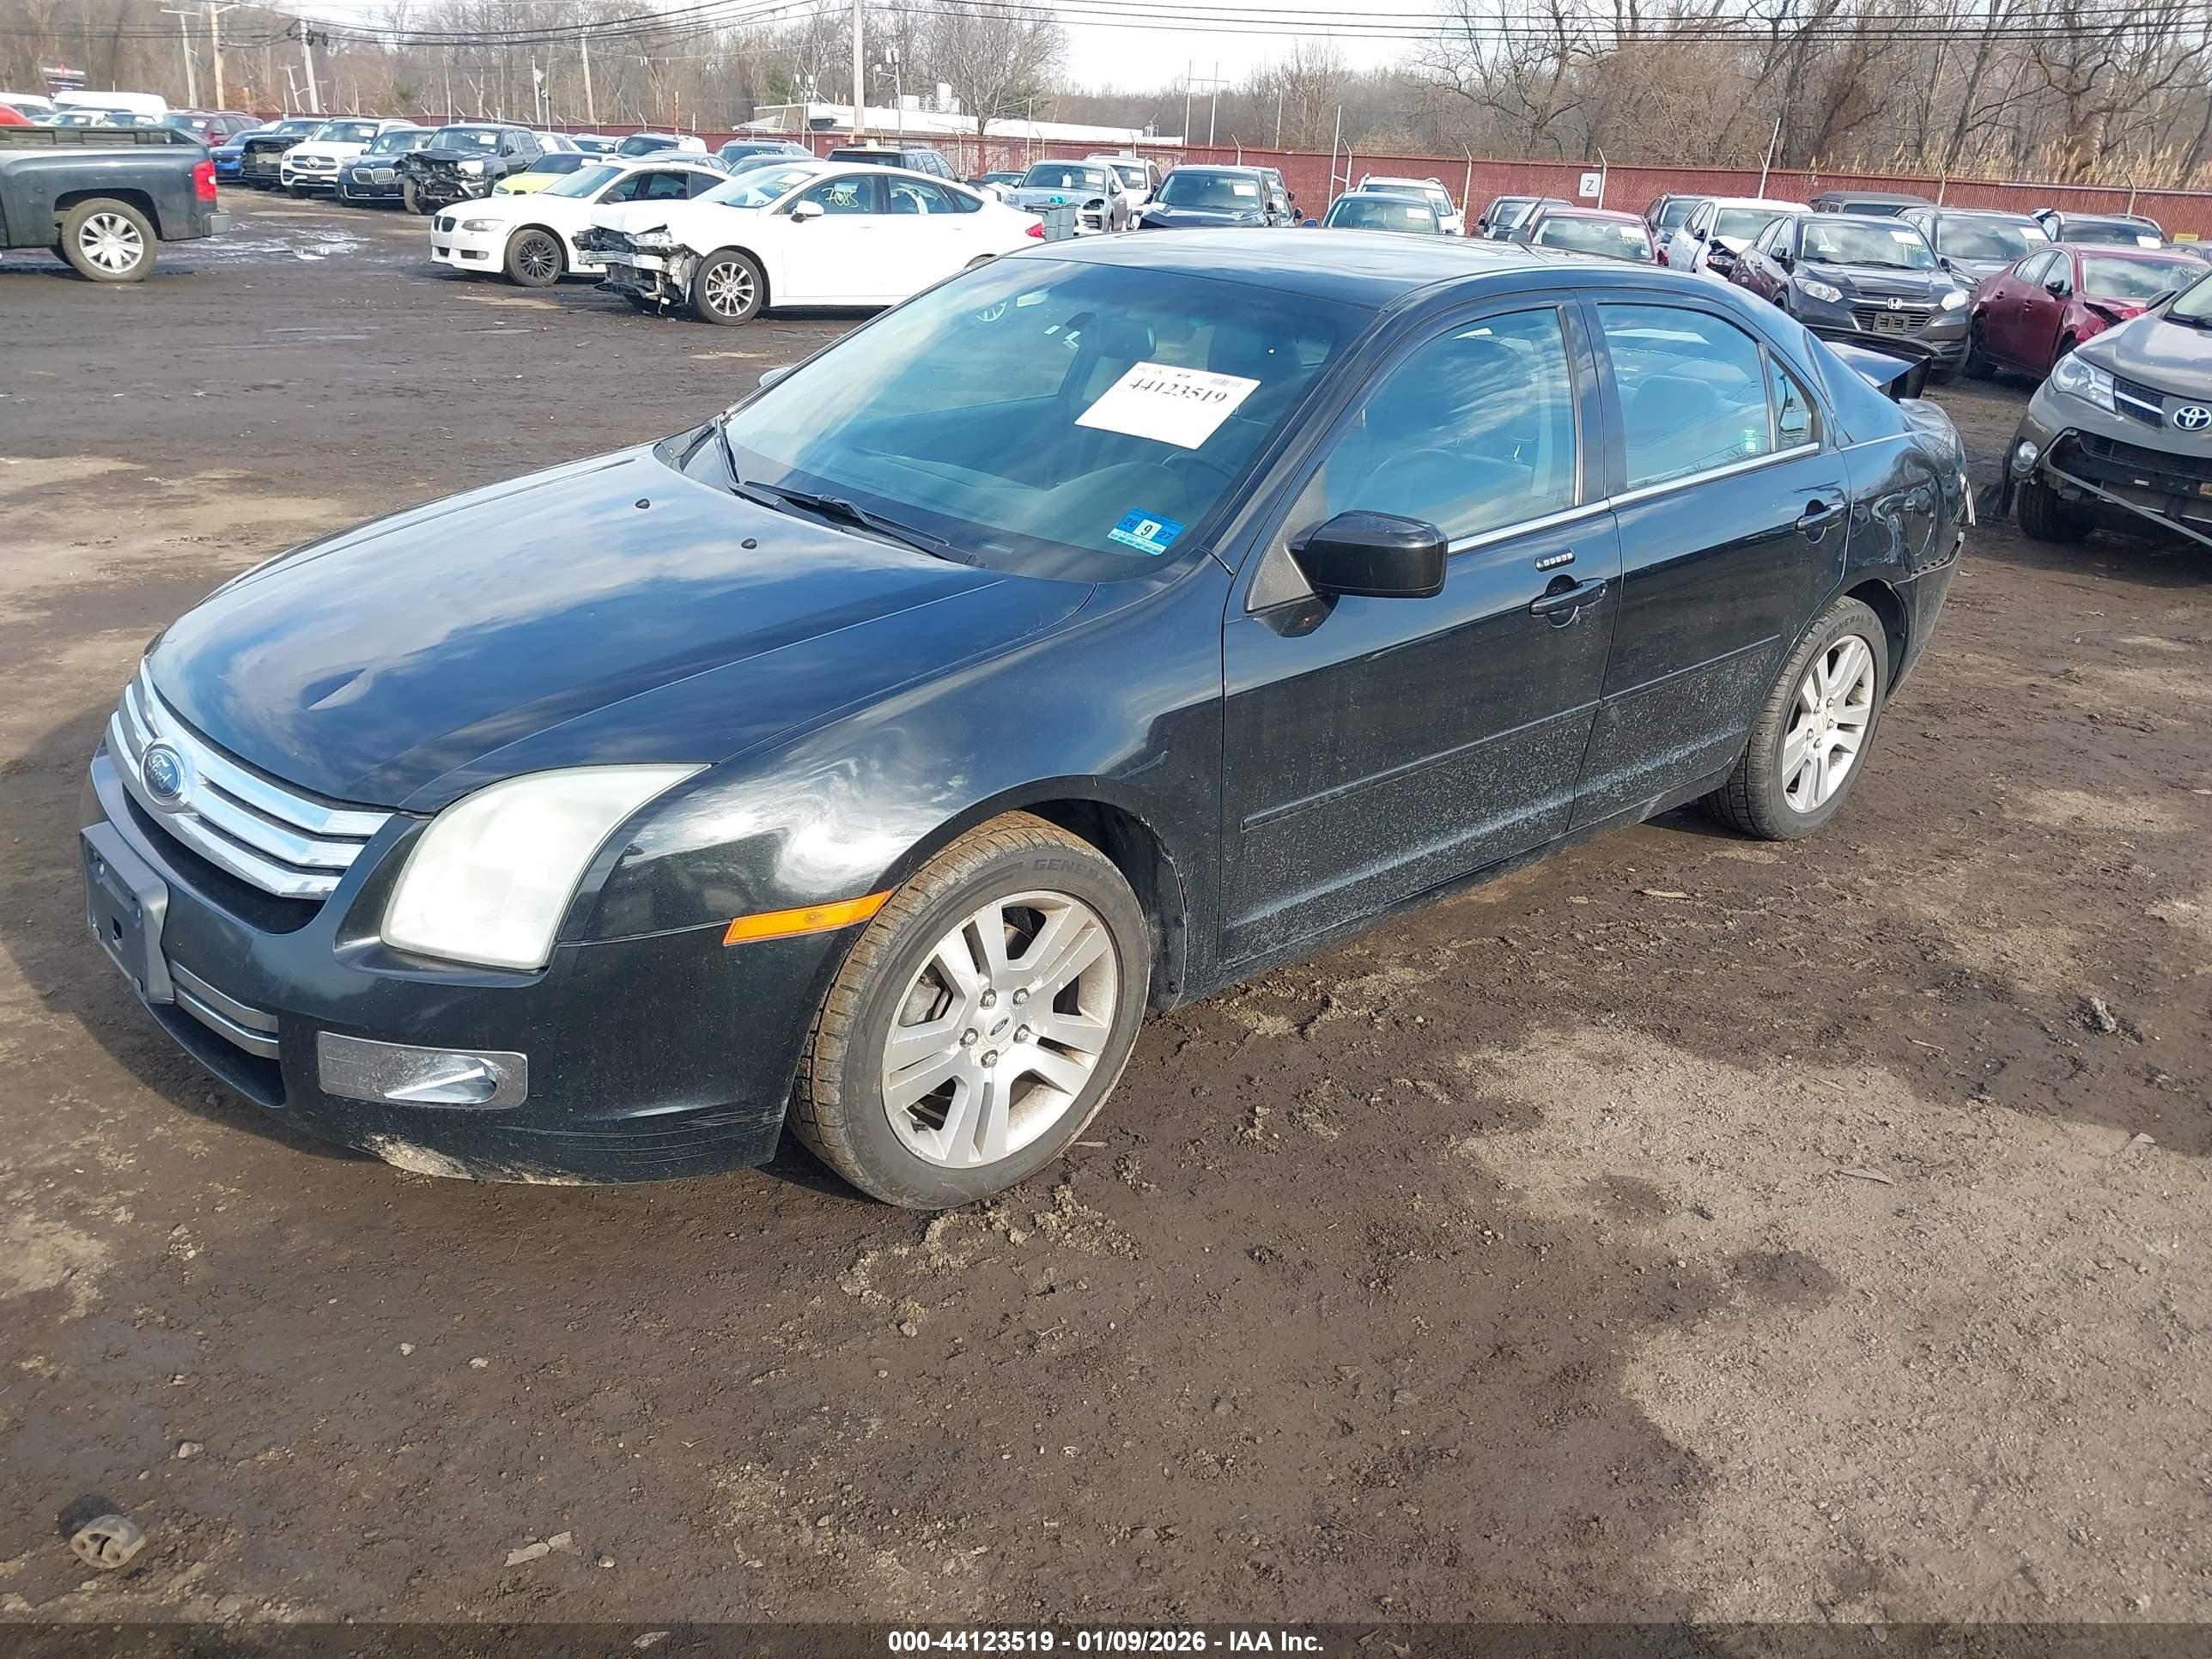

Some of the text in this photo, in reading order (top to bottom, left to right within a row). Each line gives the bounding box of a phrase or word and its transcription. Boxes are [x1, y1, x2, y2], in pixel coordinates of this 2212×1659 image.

[1585, 179, 1595, 191] Z
[821, 187, 859, 208] 7085
[1129, 379, 1228, 403] 44123519
[1140, 524, 1153, 536] 9
[144, 755, 173, 789] Ford
